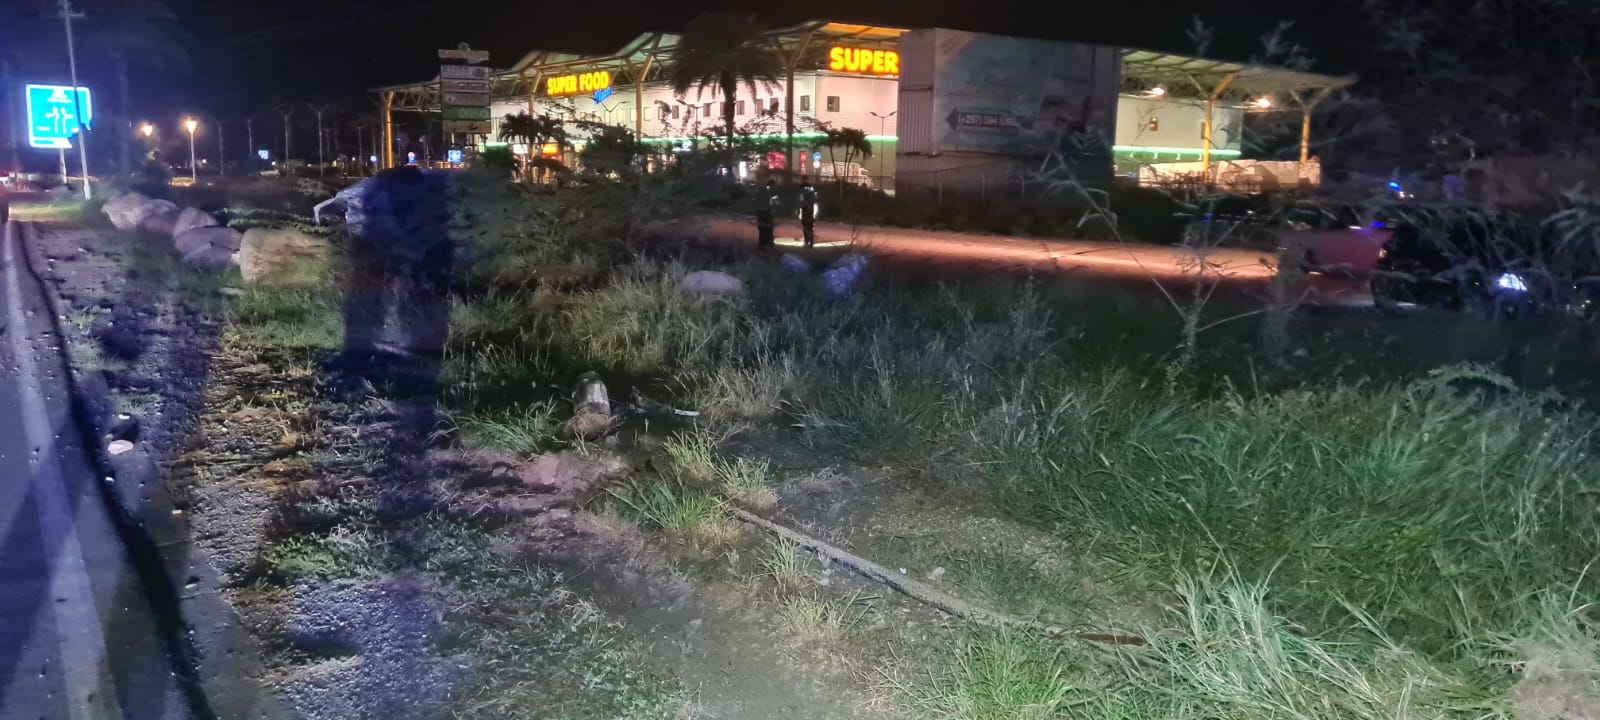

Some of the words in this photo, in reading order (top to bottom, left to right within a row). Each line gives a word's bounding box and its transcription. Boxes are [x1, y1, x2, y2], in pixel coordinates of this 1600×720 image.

[829, 46, 899, 74] SUPER
[547, 75, 577, 95] SUPER
[579, 71, 609, 91] FOOD
